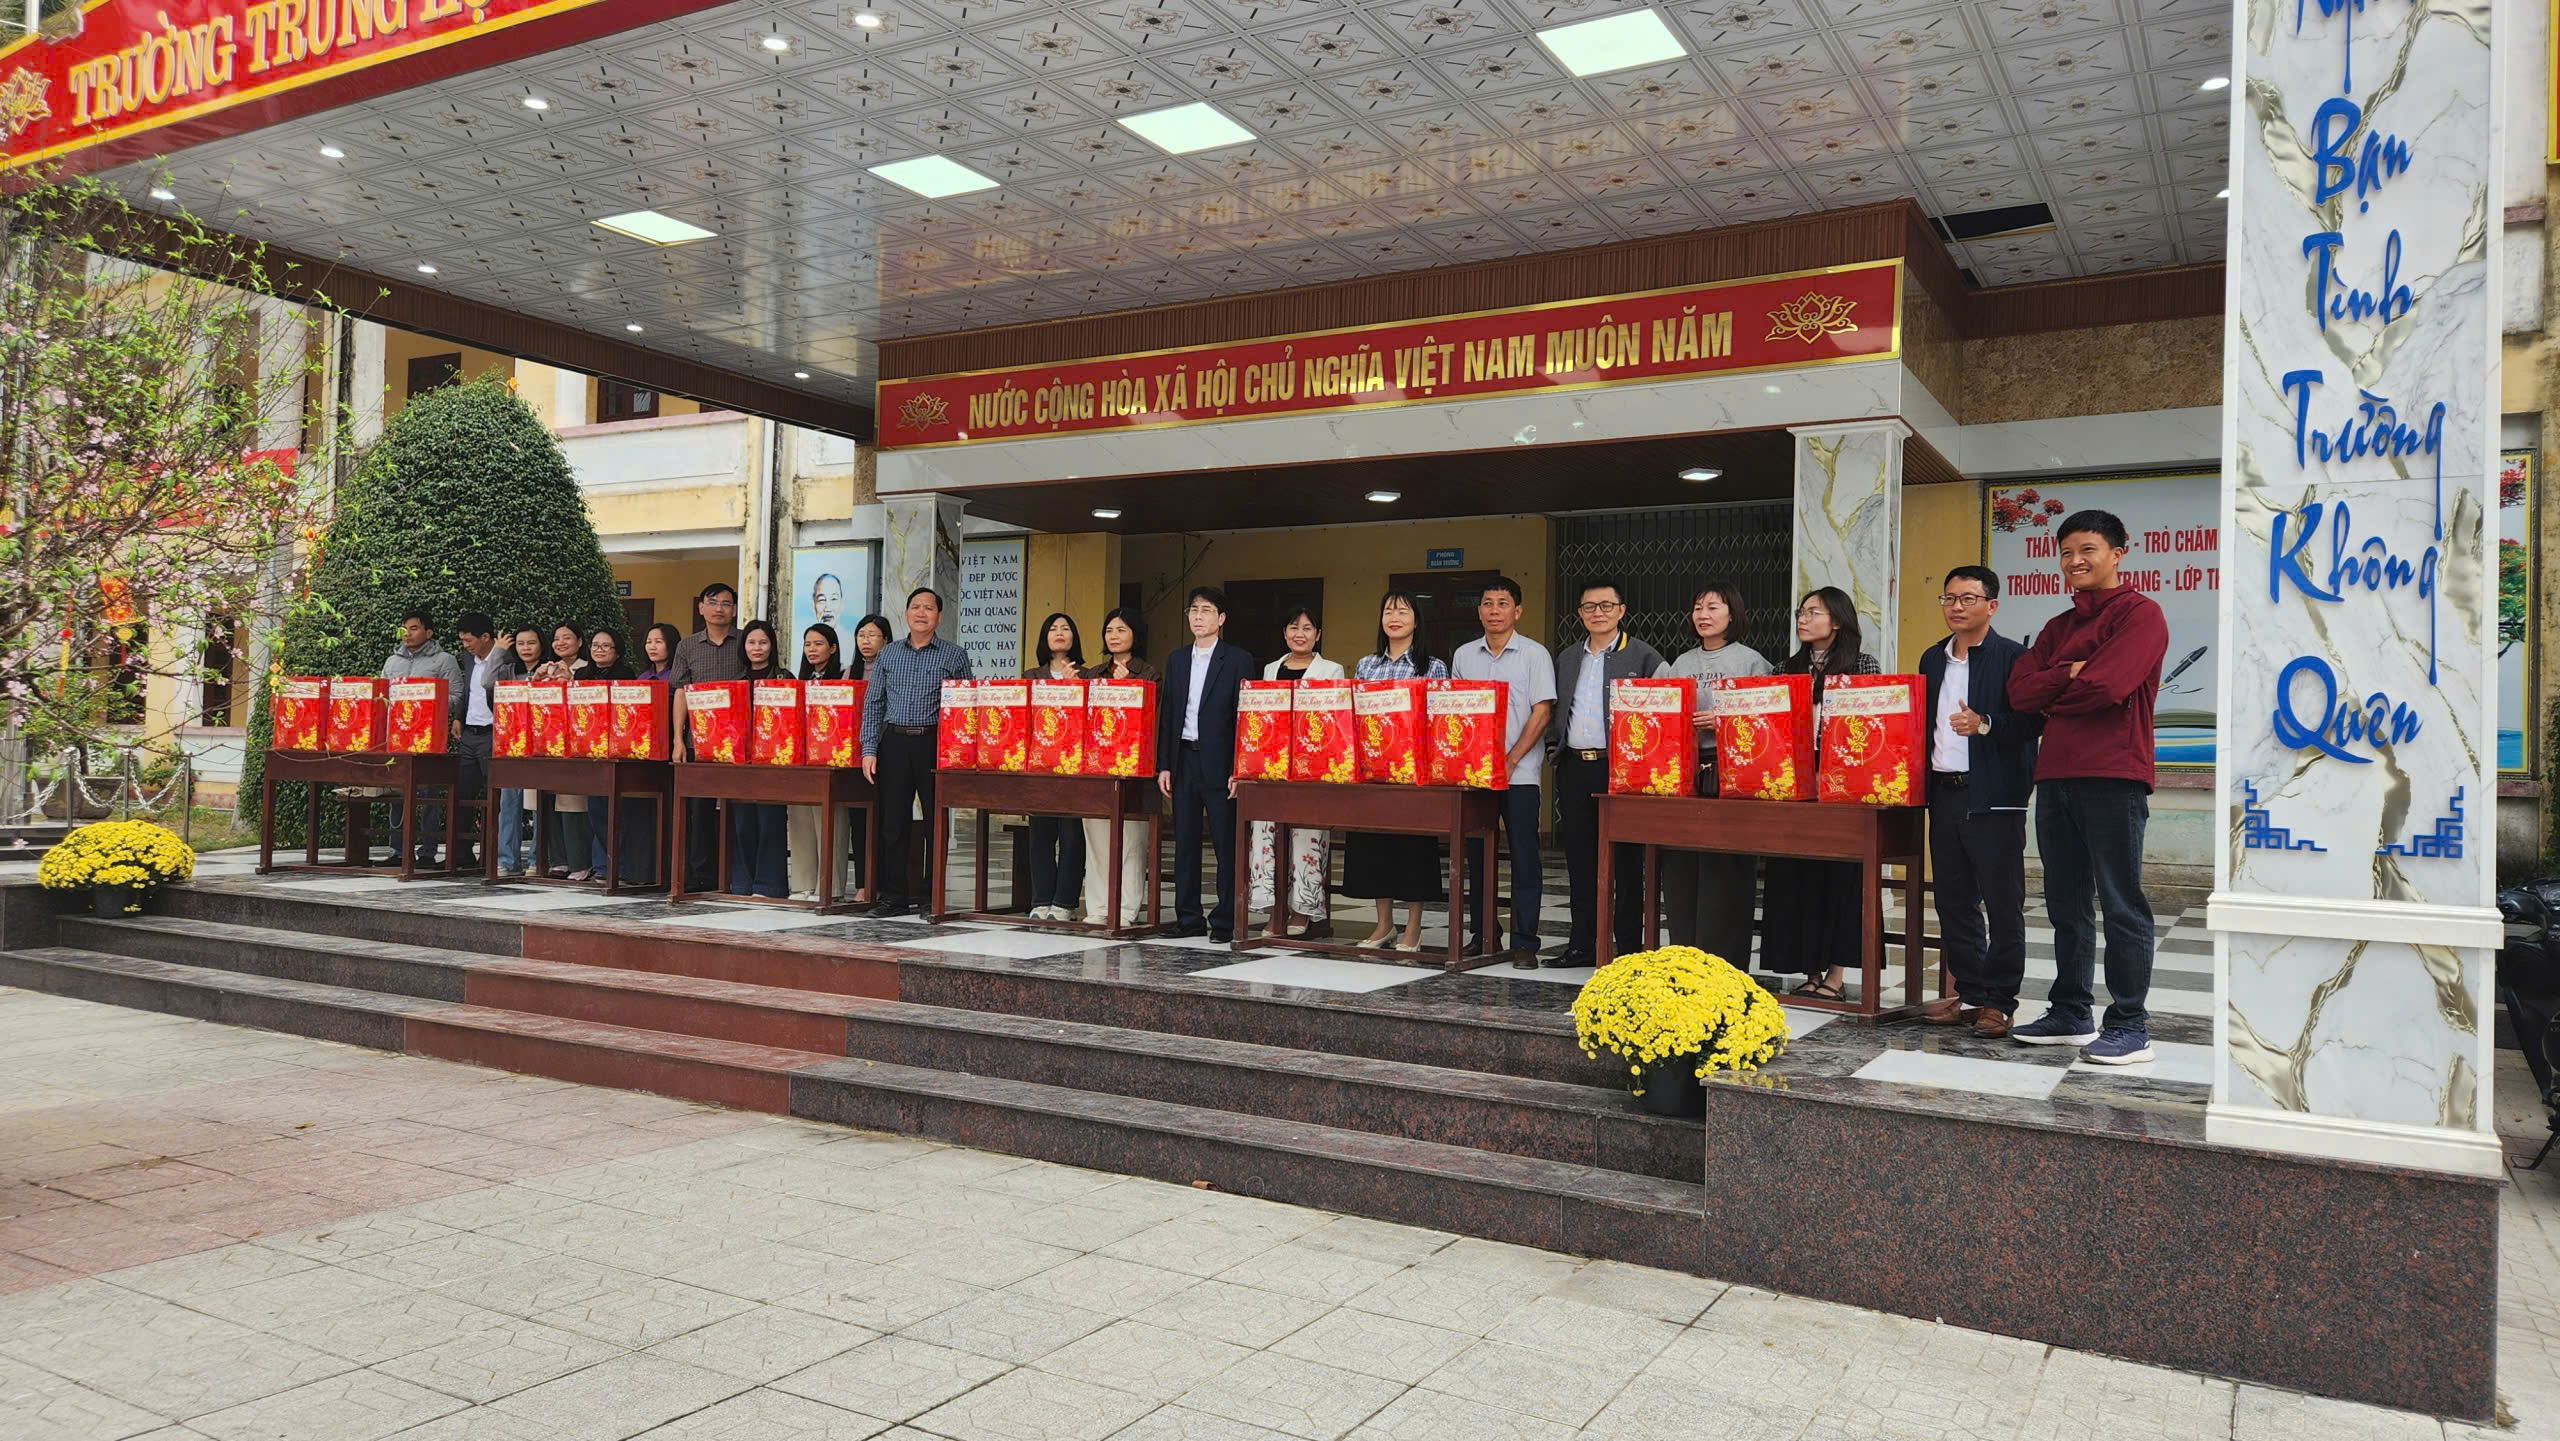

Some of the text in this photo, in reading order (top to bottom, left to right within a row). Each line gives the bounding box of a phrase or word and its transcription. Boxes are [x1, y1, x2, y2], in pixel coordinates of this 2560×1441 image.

[69, 0, 407, 127] TRƯỜNG TRUNG
[2310, 97, 2414, 213] Bạn
[2302, 229, 2417, 334] Tình
[968, 305, 1734, 430] NƯỚC CỘNG HÒA XÃ HỘI CHỦ NGHĨA VIỆT NAM MUÔN NĂM
[2281, 368, 2447, 541] Trường
[2025, 528, 2059, 559] THẦY
[2143, 525, 2171, 554] TRÒ
[2175, 525, 2218, 553] CHĂM
[961, 553, 1018, 568] VIỆT NAM
[969, 571, 1018, 584] ĐẸP ĐƯỢC
[2006, 568, 2060, 596] TRƯỜNG
[2175, 564, 2203, 591] LỚP
[2270, 500, 2439, 686] Không
[973, 587, 994, 601] VIỆT
[996, 589, 1018, 599] NAM
[960, 606, 1017, 617] VINH QUANG
[961, 621, 1017, 634] CÁC CƯỜNG
[964, 641, 1017, 653] ĐƯỢC HAY
[970, 655, 1017, 668] LÀ NHỜ
[1706, 672, 1725, 680] DAY
[2272, 655, 2424, 764] Quên
